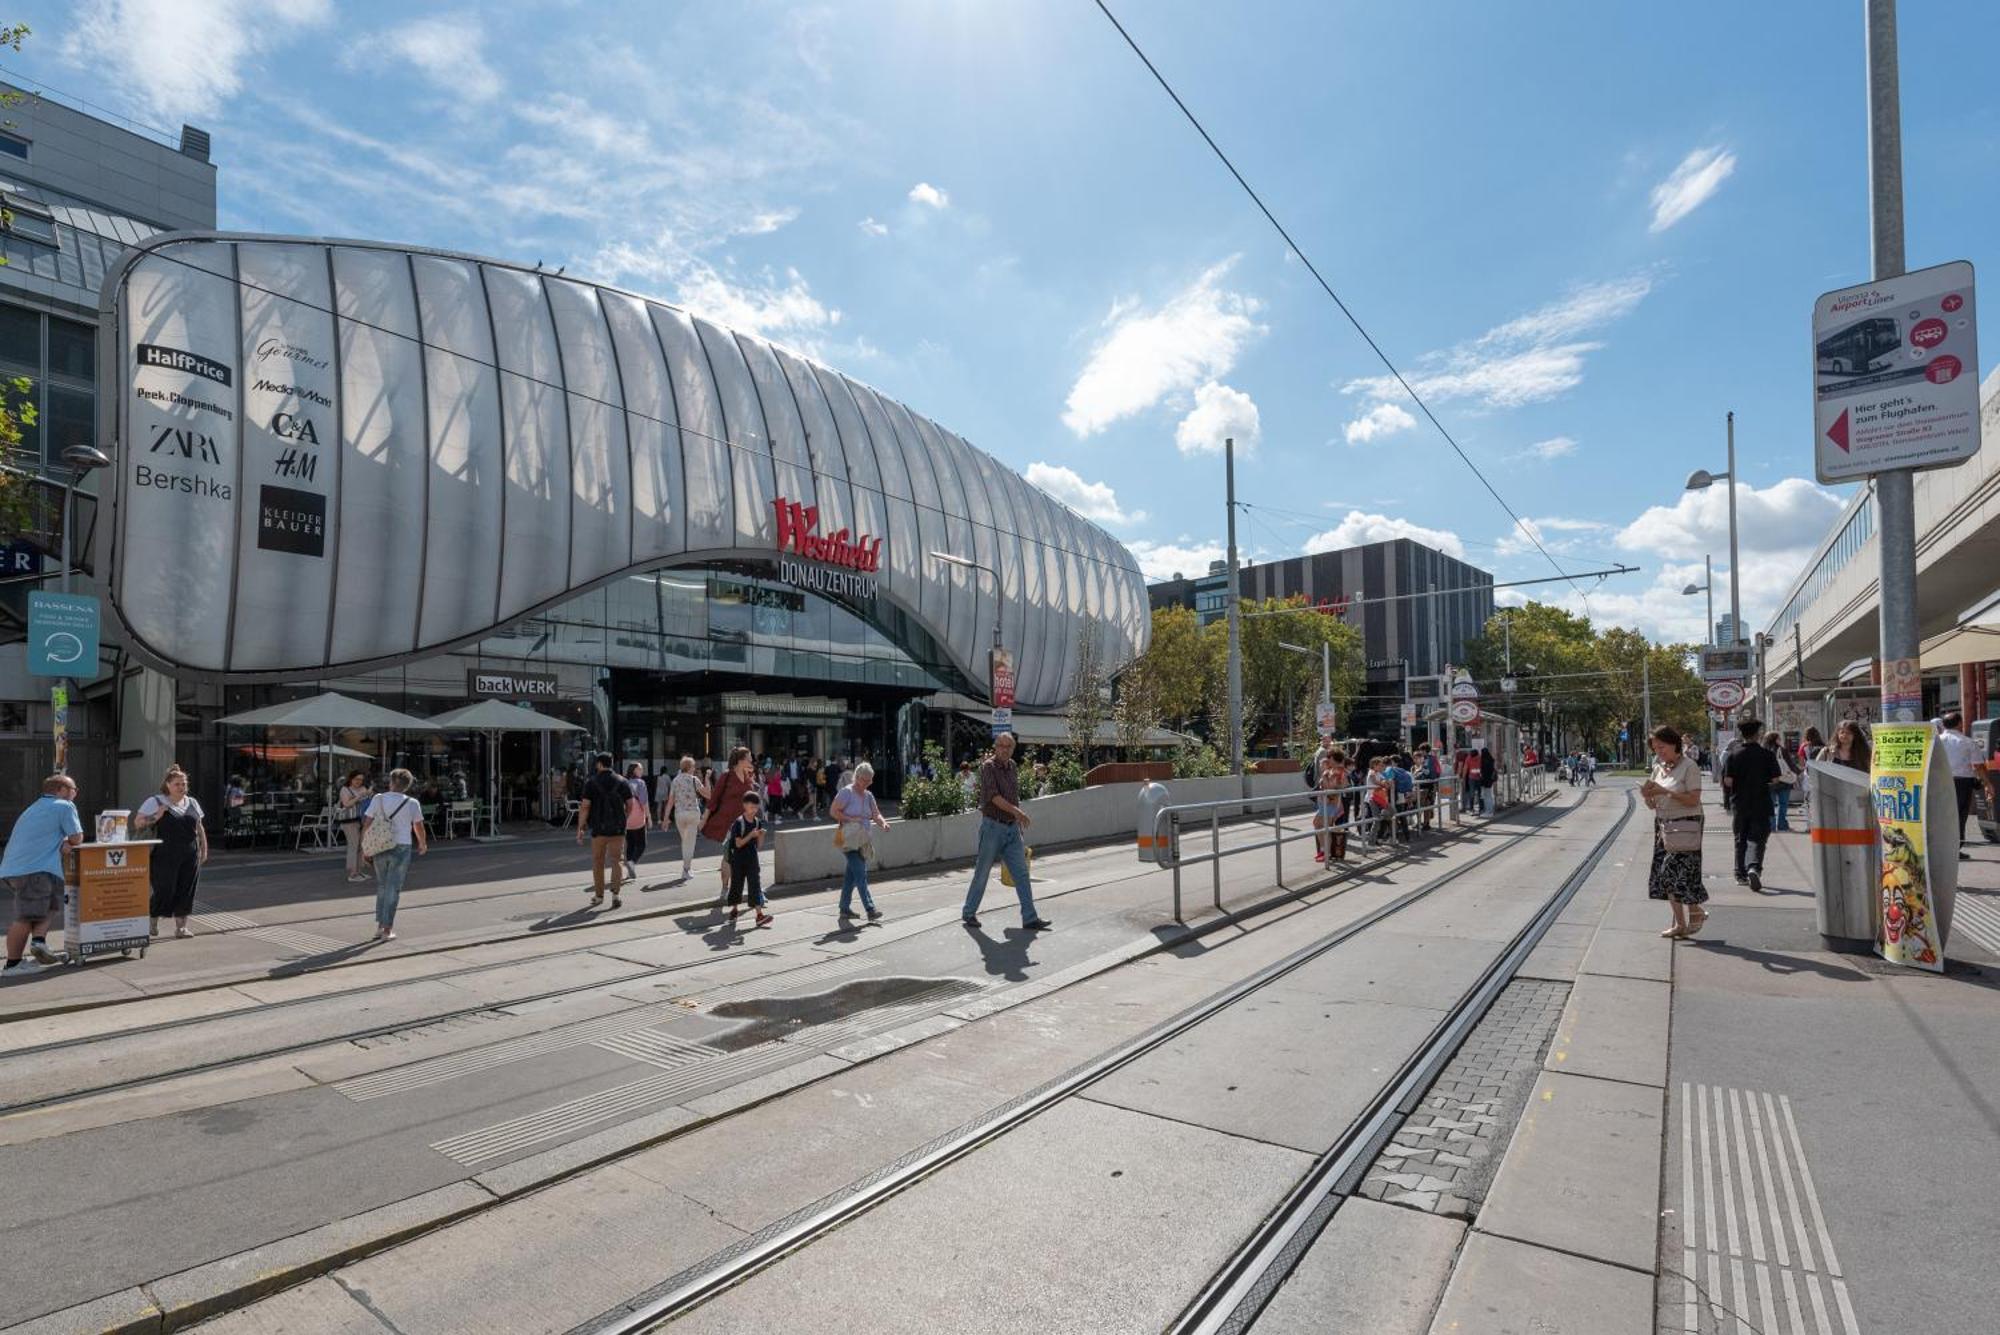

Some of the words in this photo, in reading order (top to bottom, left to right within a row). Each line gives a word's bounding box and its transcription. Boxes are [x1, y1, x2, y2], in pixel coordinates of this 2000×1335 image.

[146, 348, 224, 381] HalfPrice
[257, 338, 328, 370] Gourmet
[1855, 402, 1877, 414] Hier
[1855, 413, 1878, 424] zum
[271, 412, 321, 445] C&A
[150, 425, 220, 465] ZARA
[275, 448, 317, 483] H&M
[136, 465, 231, 500] Bershka
[264, 507, 321, 525] KLEIDER
[264, 518, 321, 536] BAUER
[771, 497, 883, 573] Westfield
[1882, 735, 1924, 744] Bezirk
